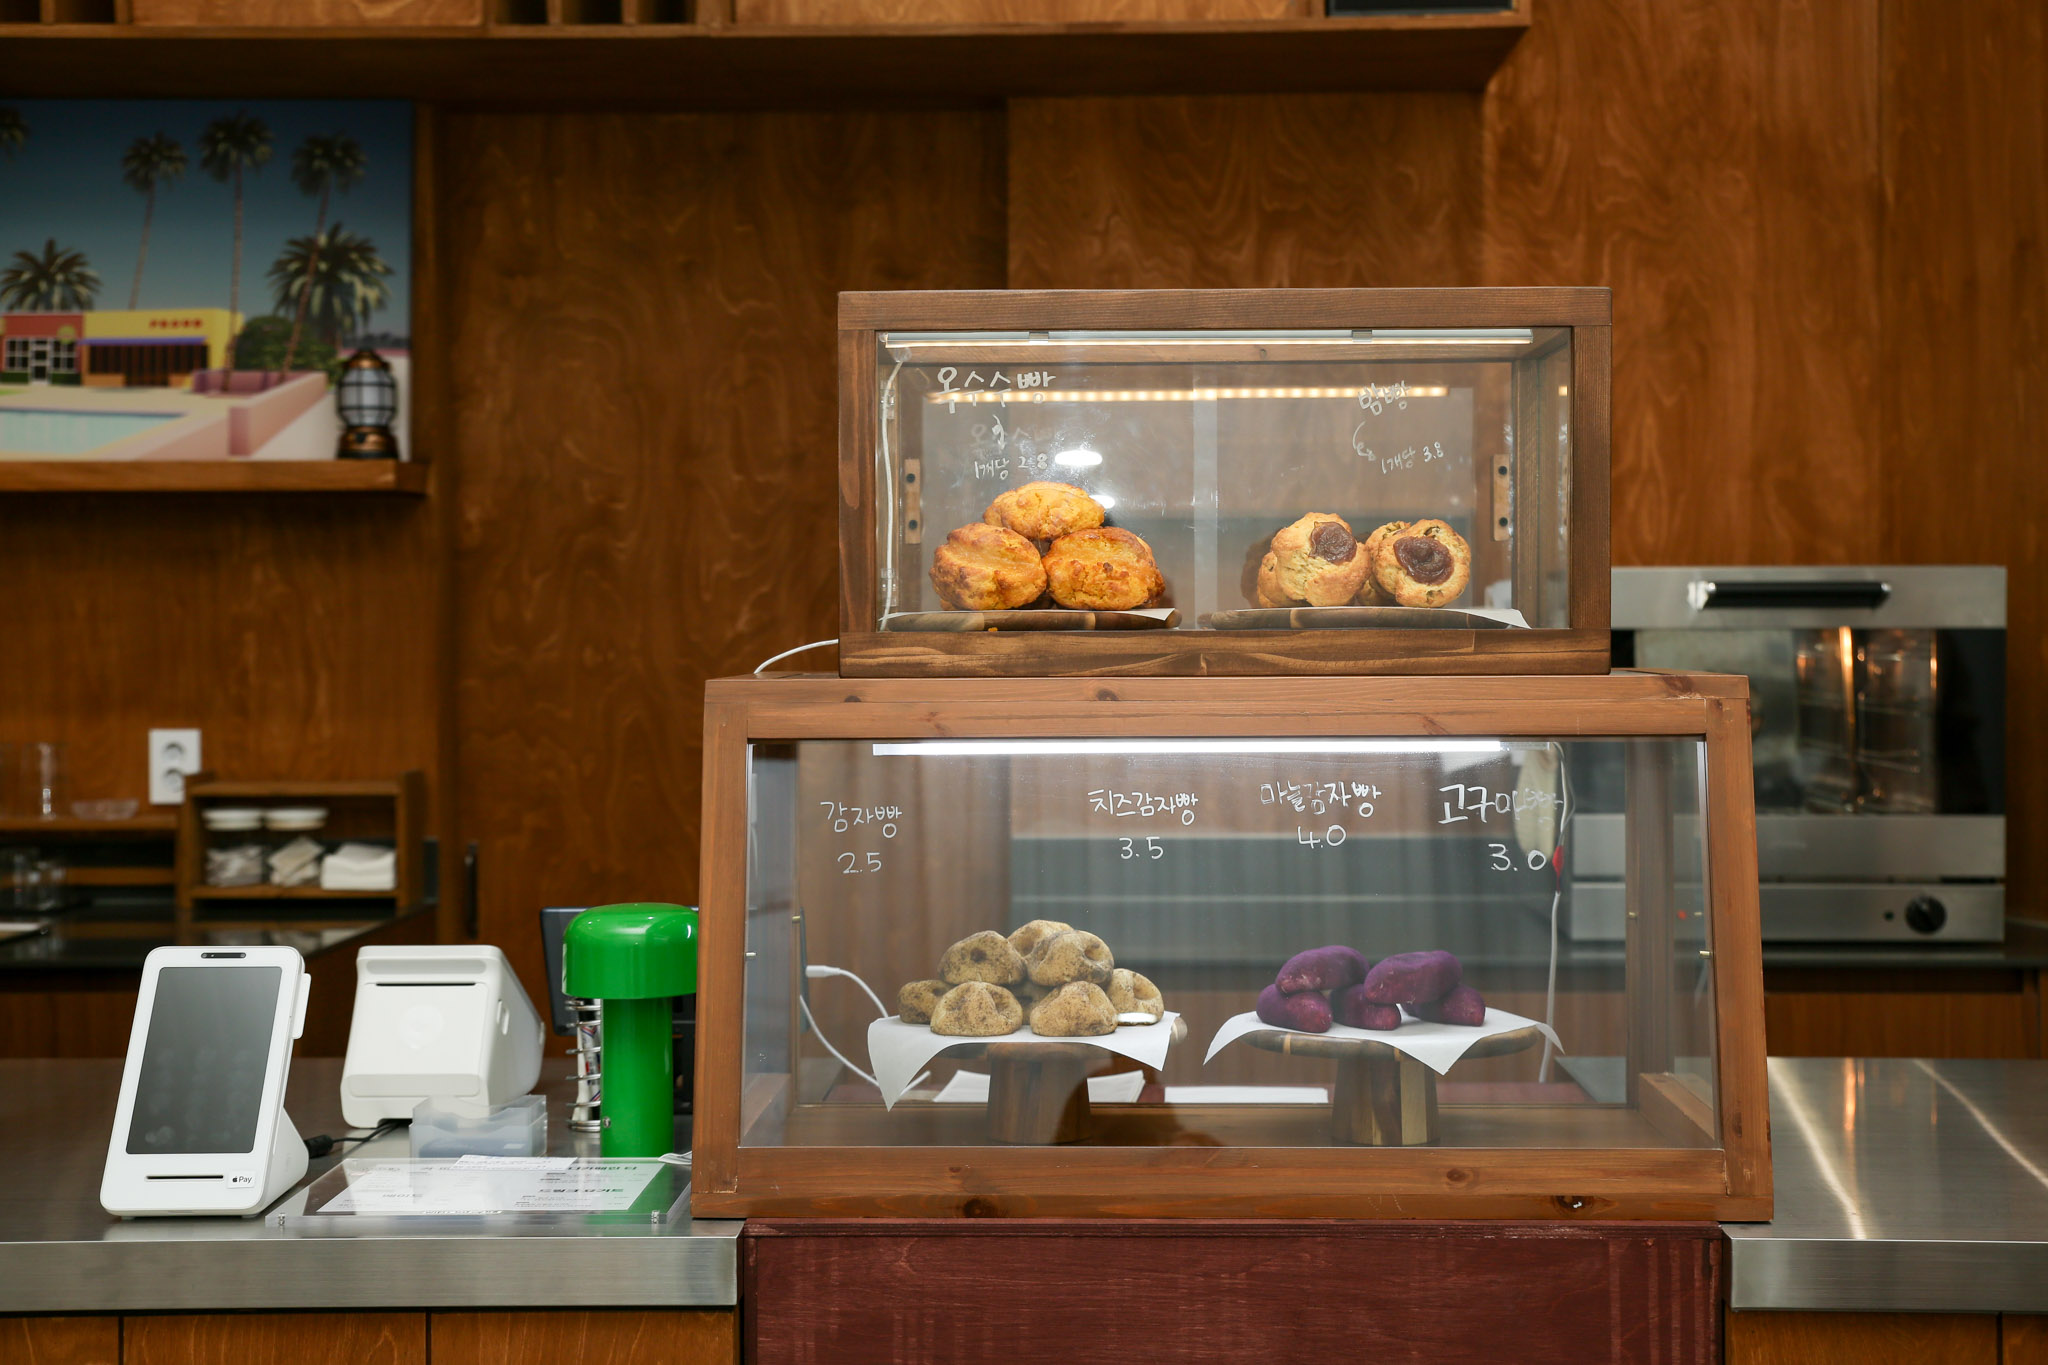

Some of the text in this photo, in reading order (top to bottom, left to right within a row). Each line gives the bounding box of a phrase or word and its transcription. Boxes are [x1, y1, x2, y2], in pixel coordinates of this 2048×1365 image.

[936, 366, 1056, 414] 옥수수빵
[1357, 380, 1411, 416] 밤빵
[1423, 441, 1444, 462] 3.8
[1087, 789, 1199, 826] 치즈감자빵
[1260, 780, 1382, 818] 마늘감자빵
[820, 801, 902, 838] 감자빵
[1118, 836, 1164, 860] 3.5
[1297, 823, 1347, 850] 4.0
[837, 852, 882, 875] 2.5
[1488, 843, 1547, 872] 3.0
[238, 1175, 253, 1184] Pay
